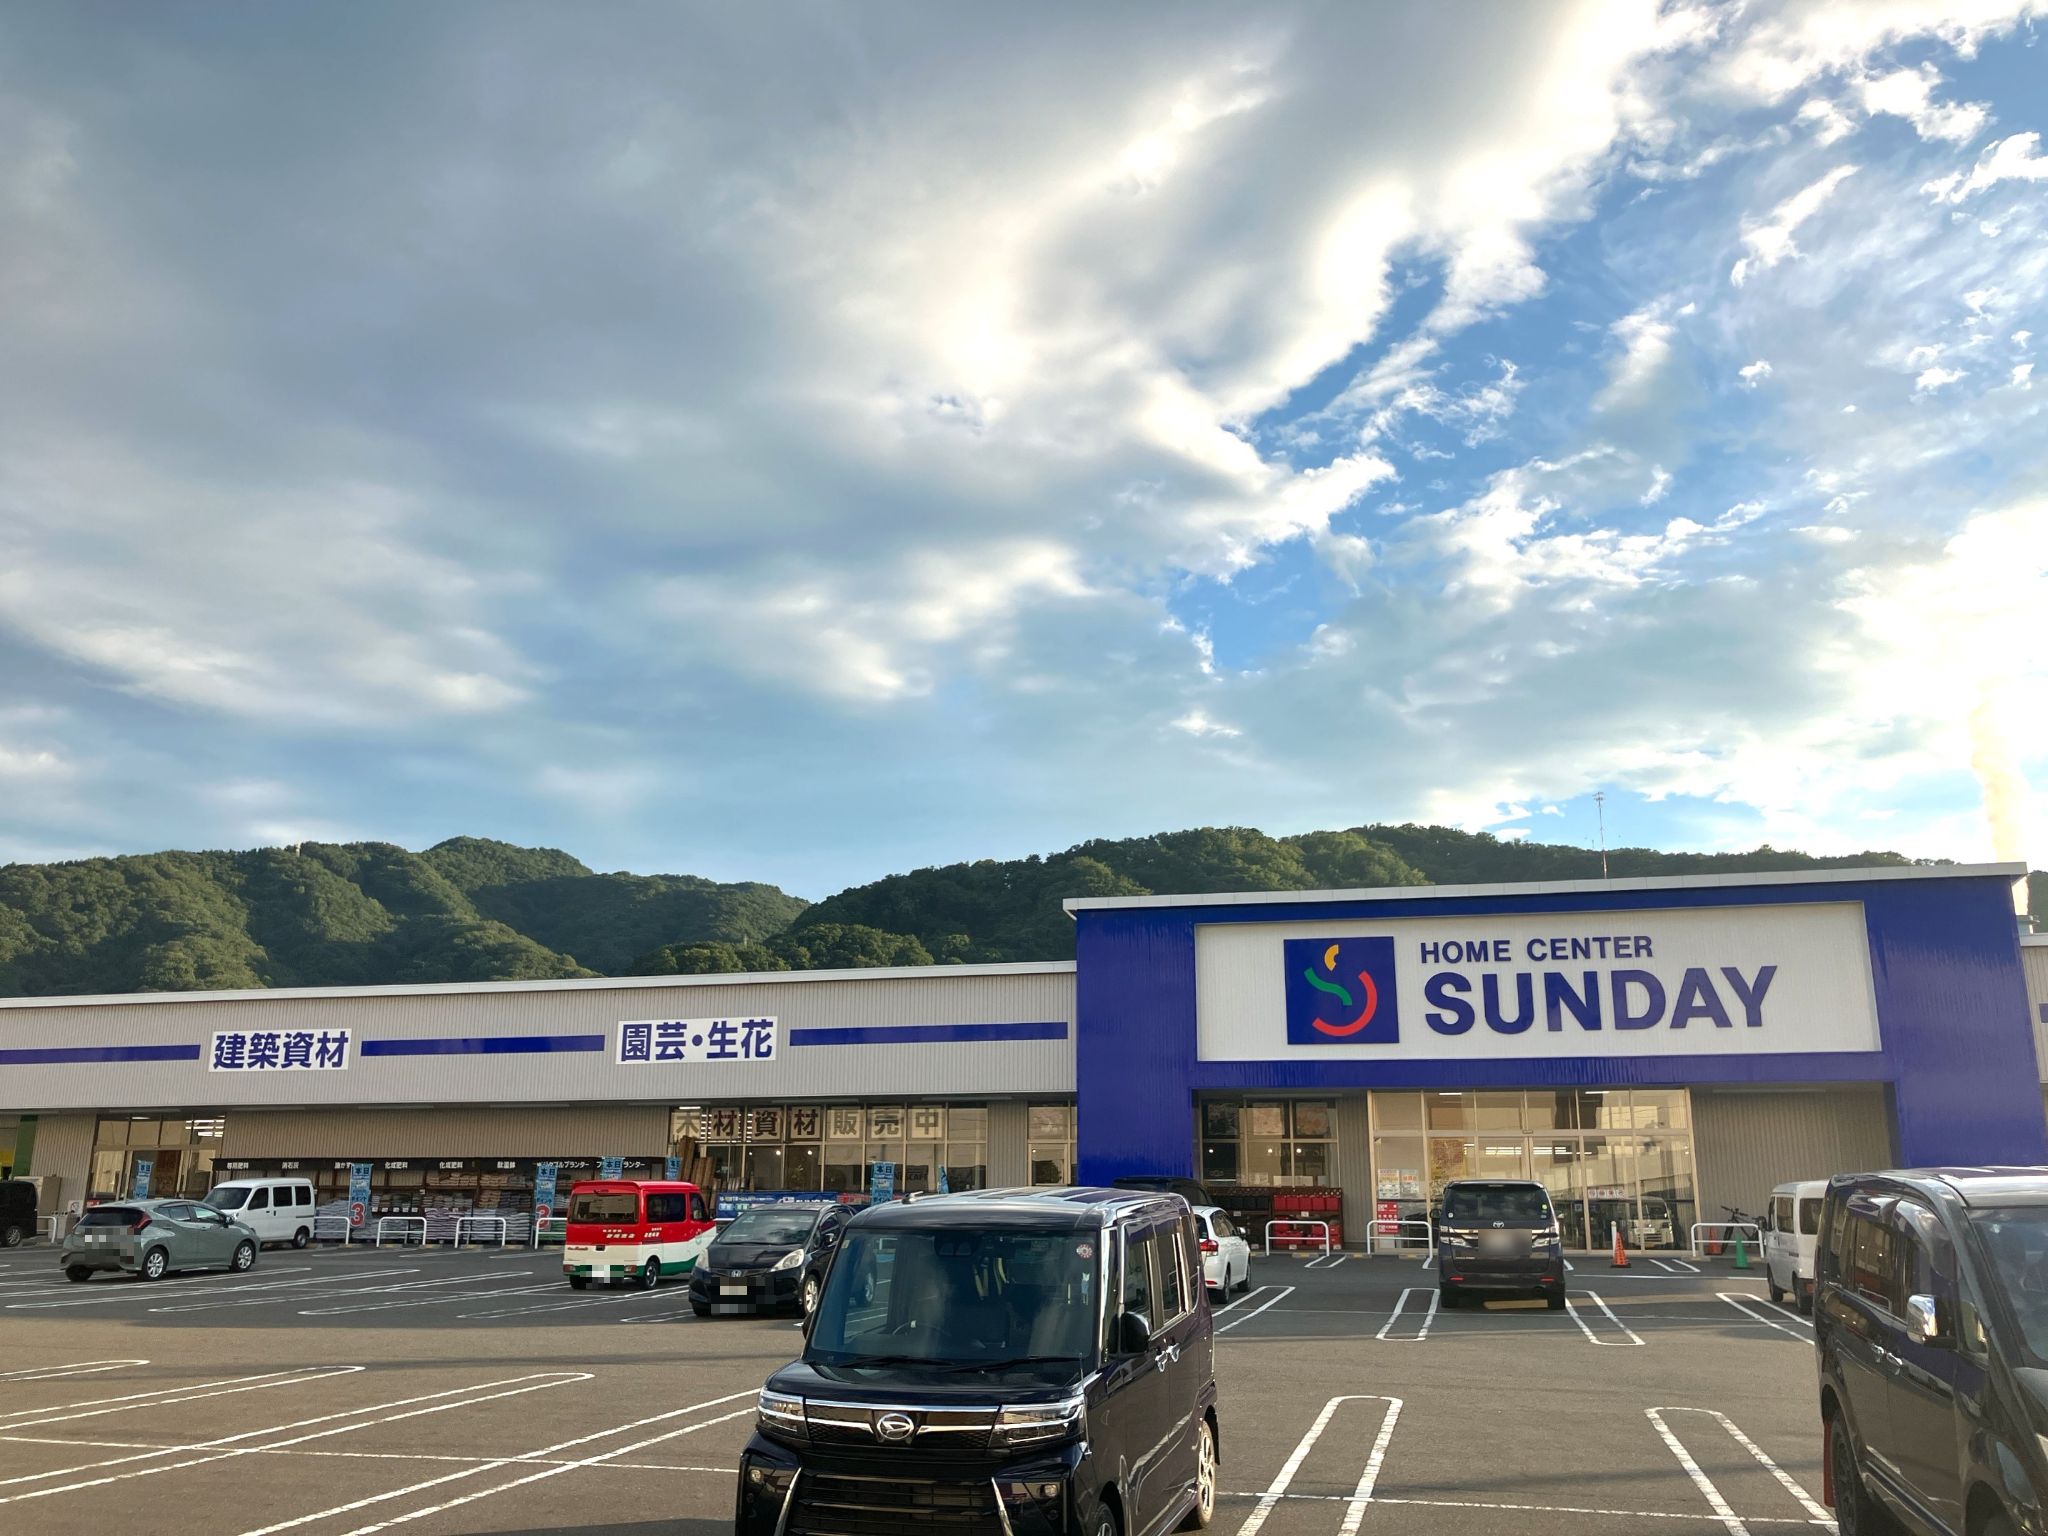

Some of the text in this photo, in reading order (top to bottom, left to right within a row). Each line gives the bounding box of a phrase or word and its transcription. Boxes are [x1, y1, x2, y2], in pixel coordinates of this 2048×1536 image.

[1420, 935, 1654, 964] HOME CENTER
[1424, 965, 1778, 1036] SUNDAY
[213, 1031, 349, 1070] 建築資材
[620, 1018, 774, 1062] 園芸・生花
[676, 1108, 939, 1138] 木材資材販売中
[384, 1161, 409, 1170] 化成肥料
[540, 1168, 556, 1176] 本日
[606, 1160, 621, 1169] 本日
[876, 1165, 892, 1174] 本日
[350, 1202, 366, 1227] 3
